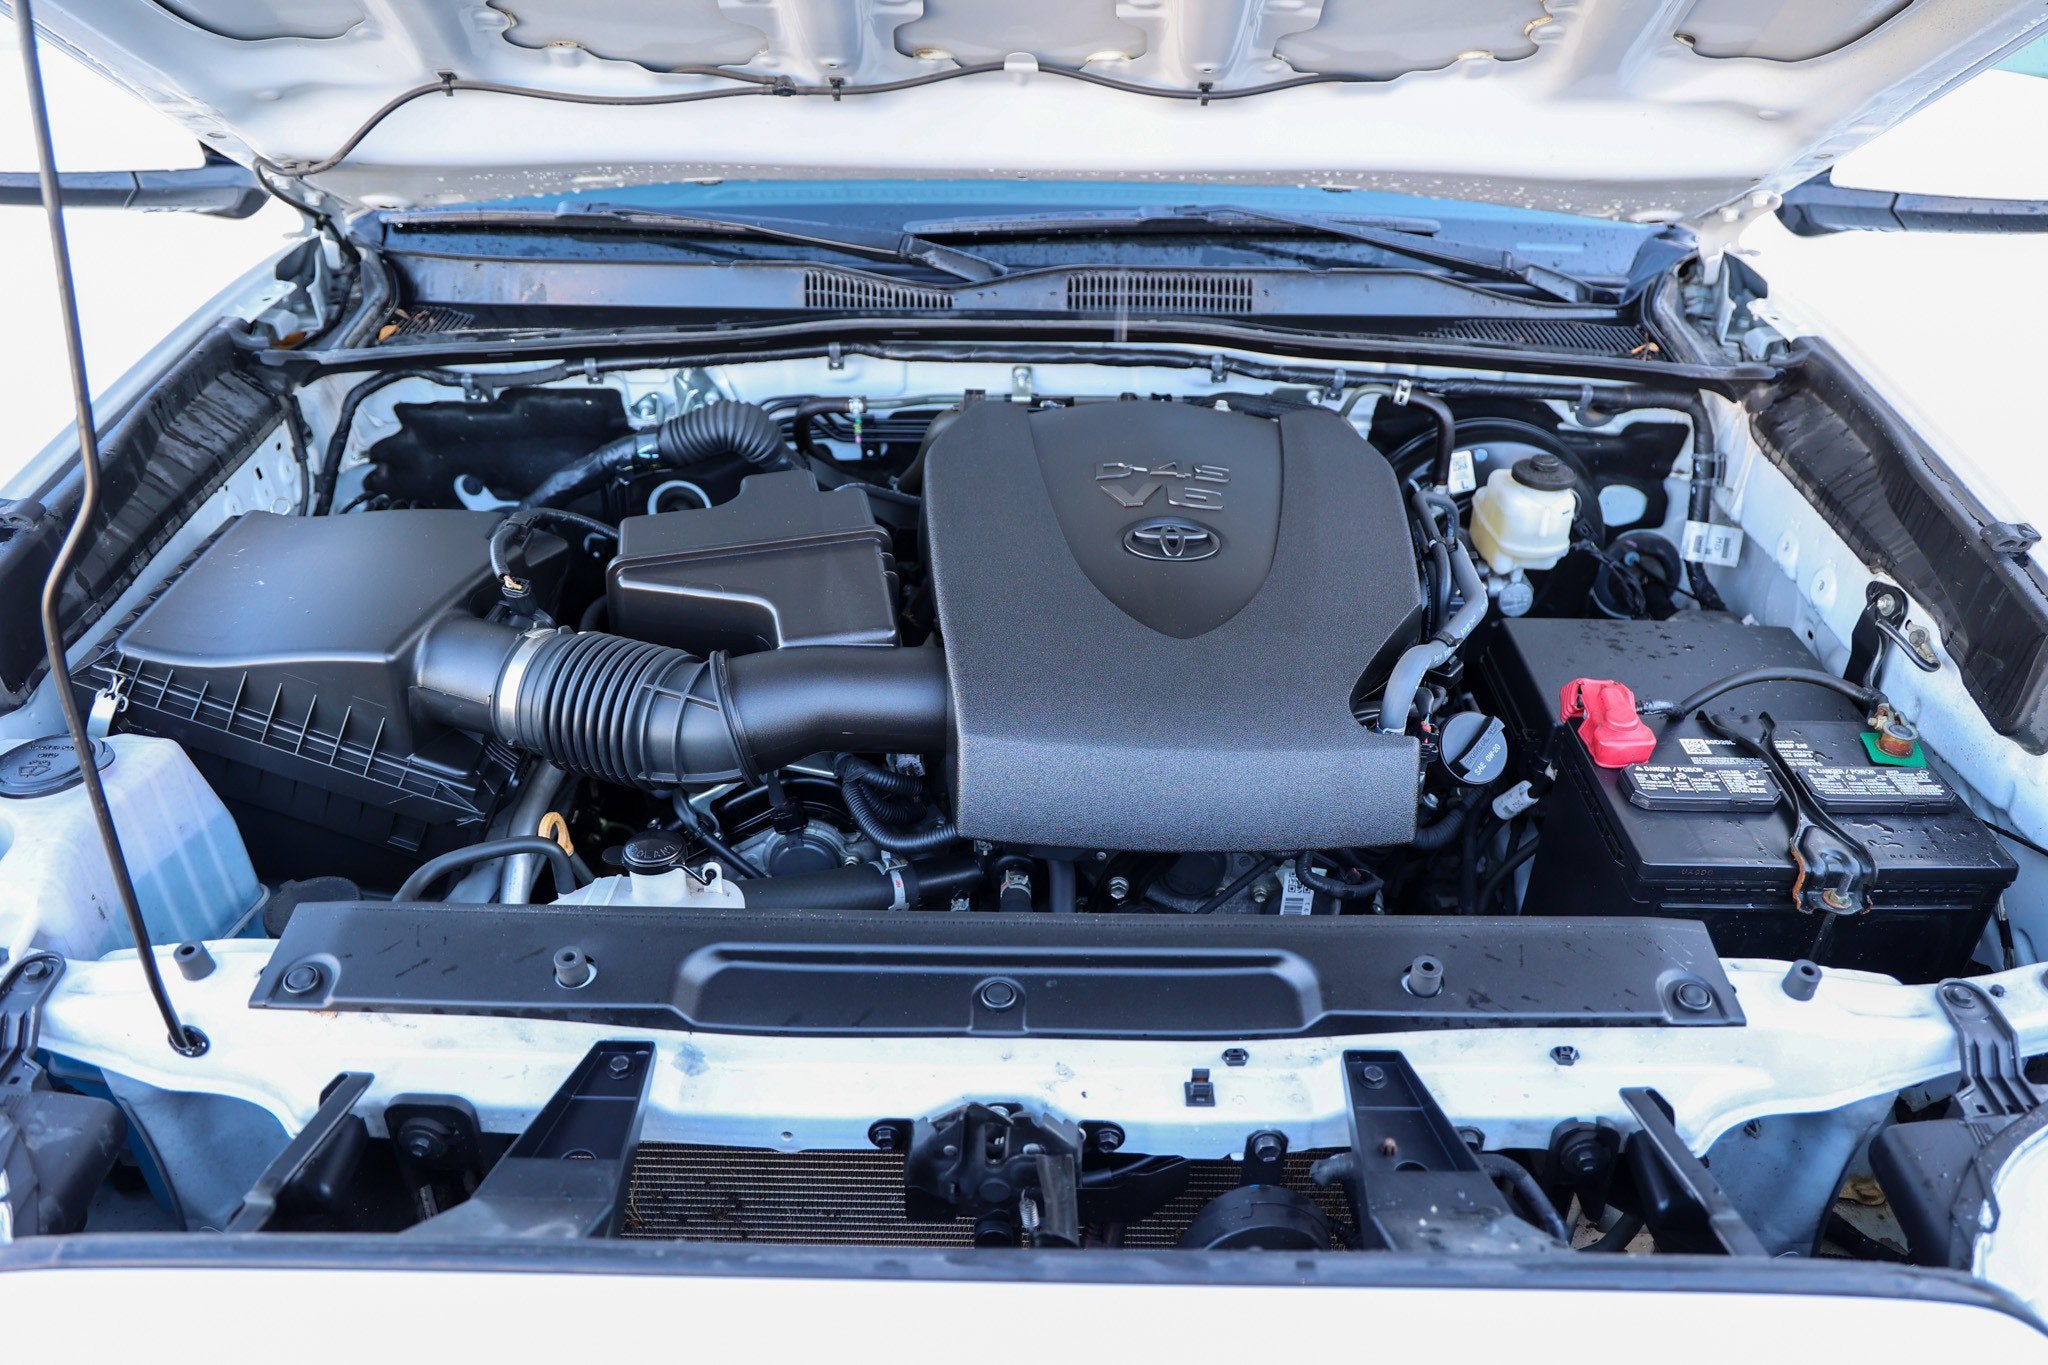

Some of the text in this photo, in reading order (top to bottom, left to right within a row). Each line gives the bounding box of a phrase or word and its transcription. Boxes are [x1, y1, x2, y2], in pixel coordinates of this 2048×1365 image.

[1100, 484, 1225, 510] V6
[1474, 762, 1487, 776] SAE
[1485, 743, 1501, 762] 0W-20
